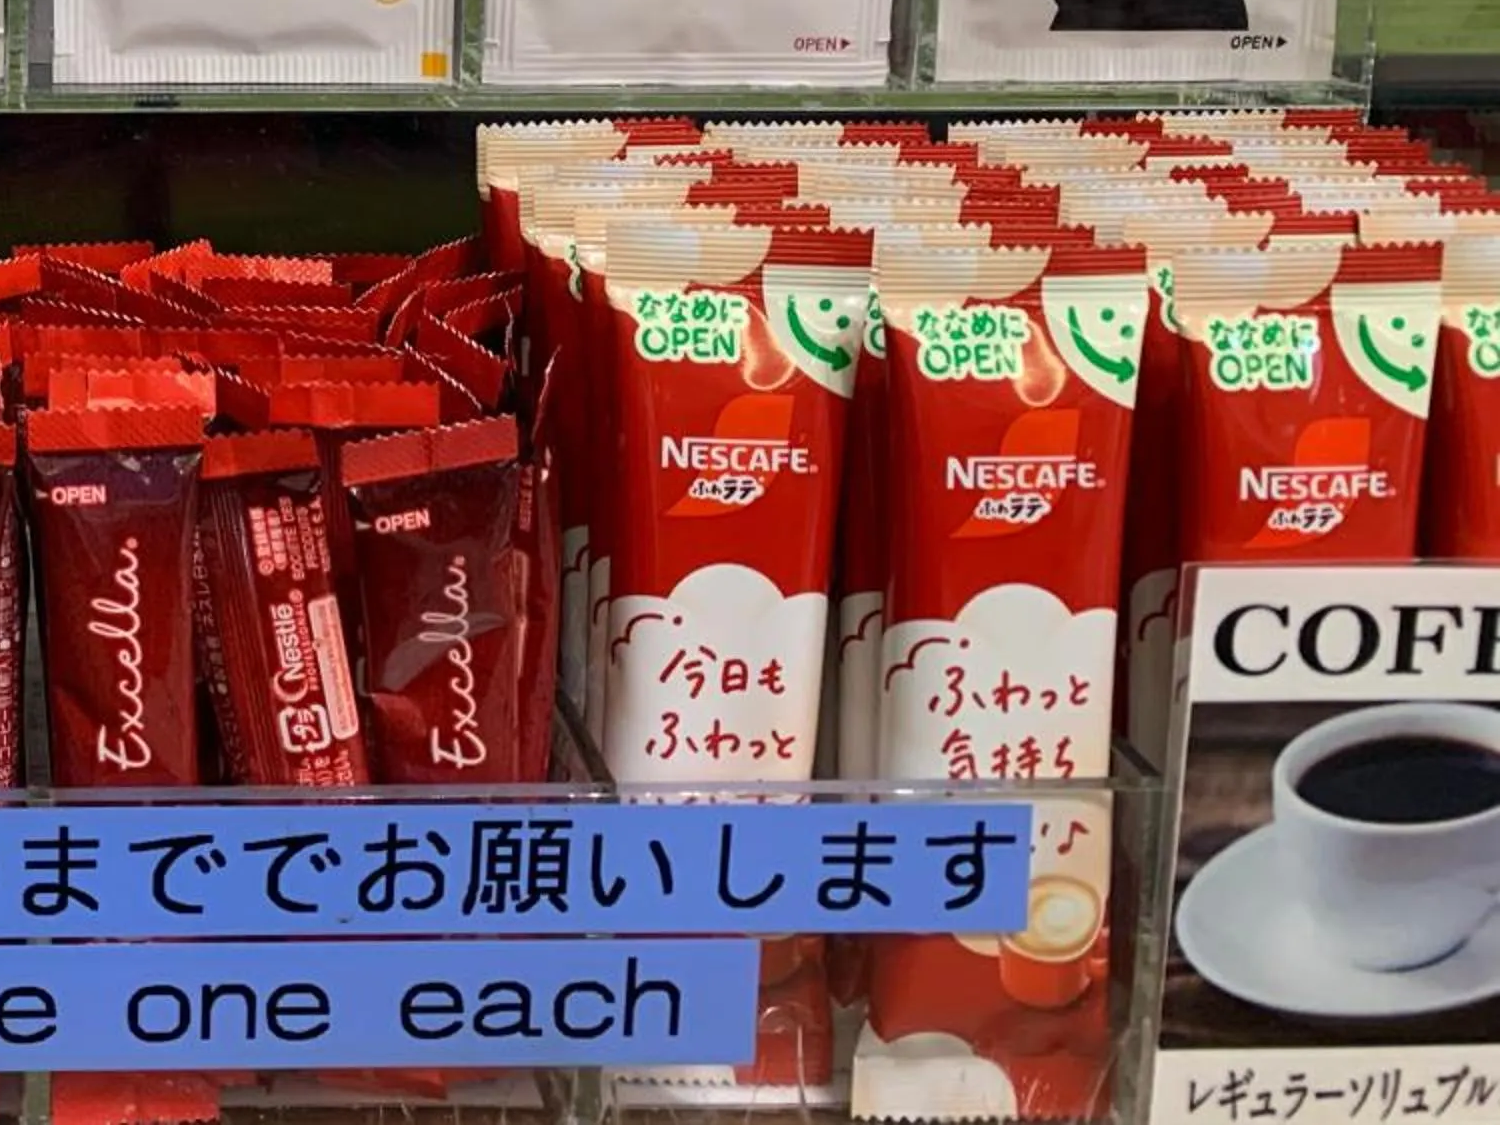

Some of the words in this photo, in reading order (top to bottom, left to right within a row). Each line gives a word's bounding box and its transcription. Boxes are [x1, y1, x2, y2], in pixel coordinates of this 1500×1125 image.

[793, 36, 837, 52] OPEN
[1230, 35, 1274, 50] OPEN
[637, 291, 743, 323] ななめに
[916, 306, 1027, 341] ななめに
[641, 326, 738, 360] OPEN
[1209, 318, 1316, 352] ななめに
[923, 344, 1019, 376] OPEN
[1216, 354, 1308, 386] OPEN
[51, 484, 107, 506] OPEN
[374, 508, 431, 535] OPEN
[271, 602, 306, 677] Nestlé
[87, 546, 151, 772] Excella
[417, 563, 487, 769] Excella
[660, 645, 786, 699] 今日も
[928, 665, 1091, 716] ふわっと
[645, 712, 797, 761] ふわっと
[941, 728, 1077, 783] 気持ち
[126, 980, 332, 1042] one
[399, 956, 682, 1040] each
